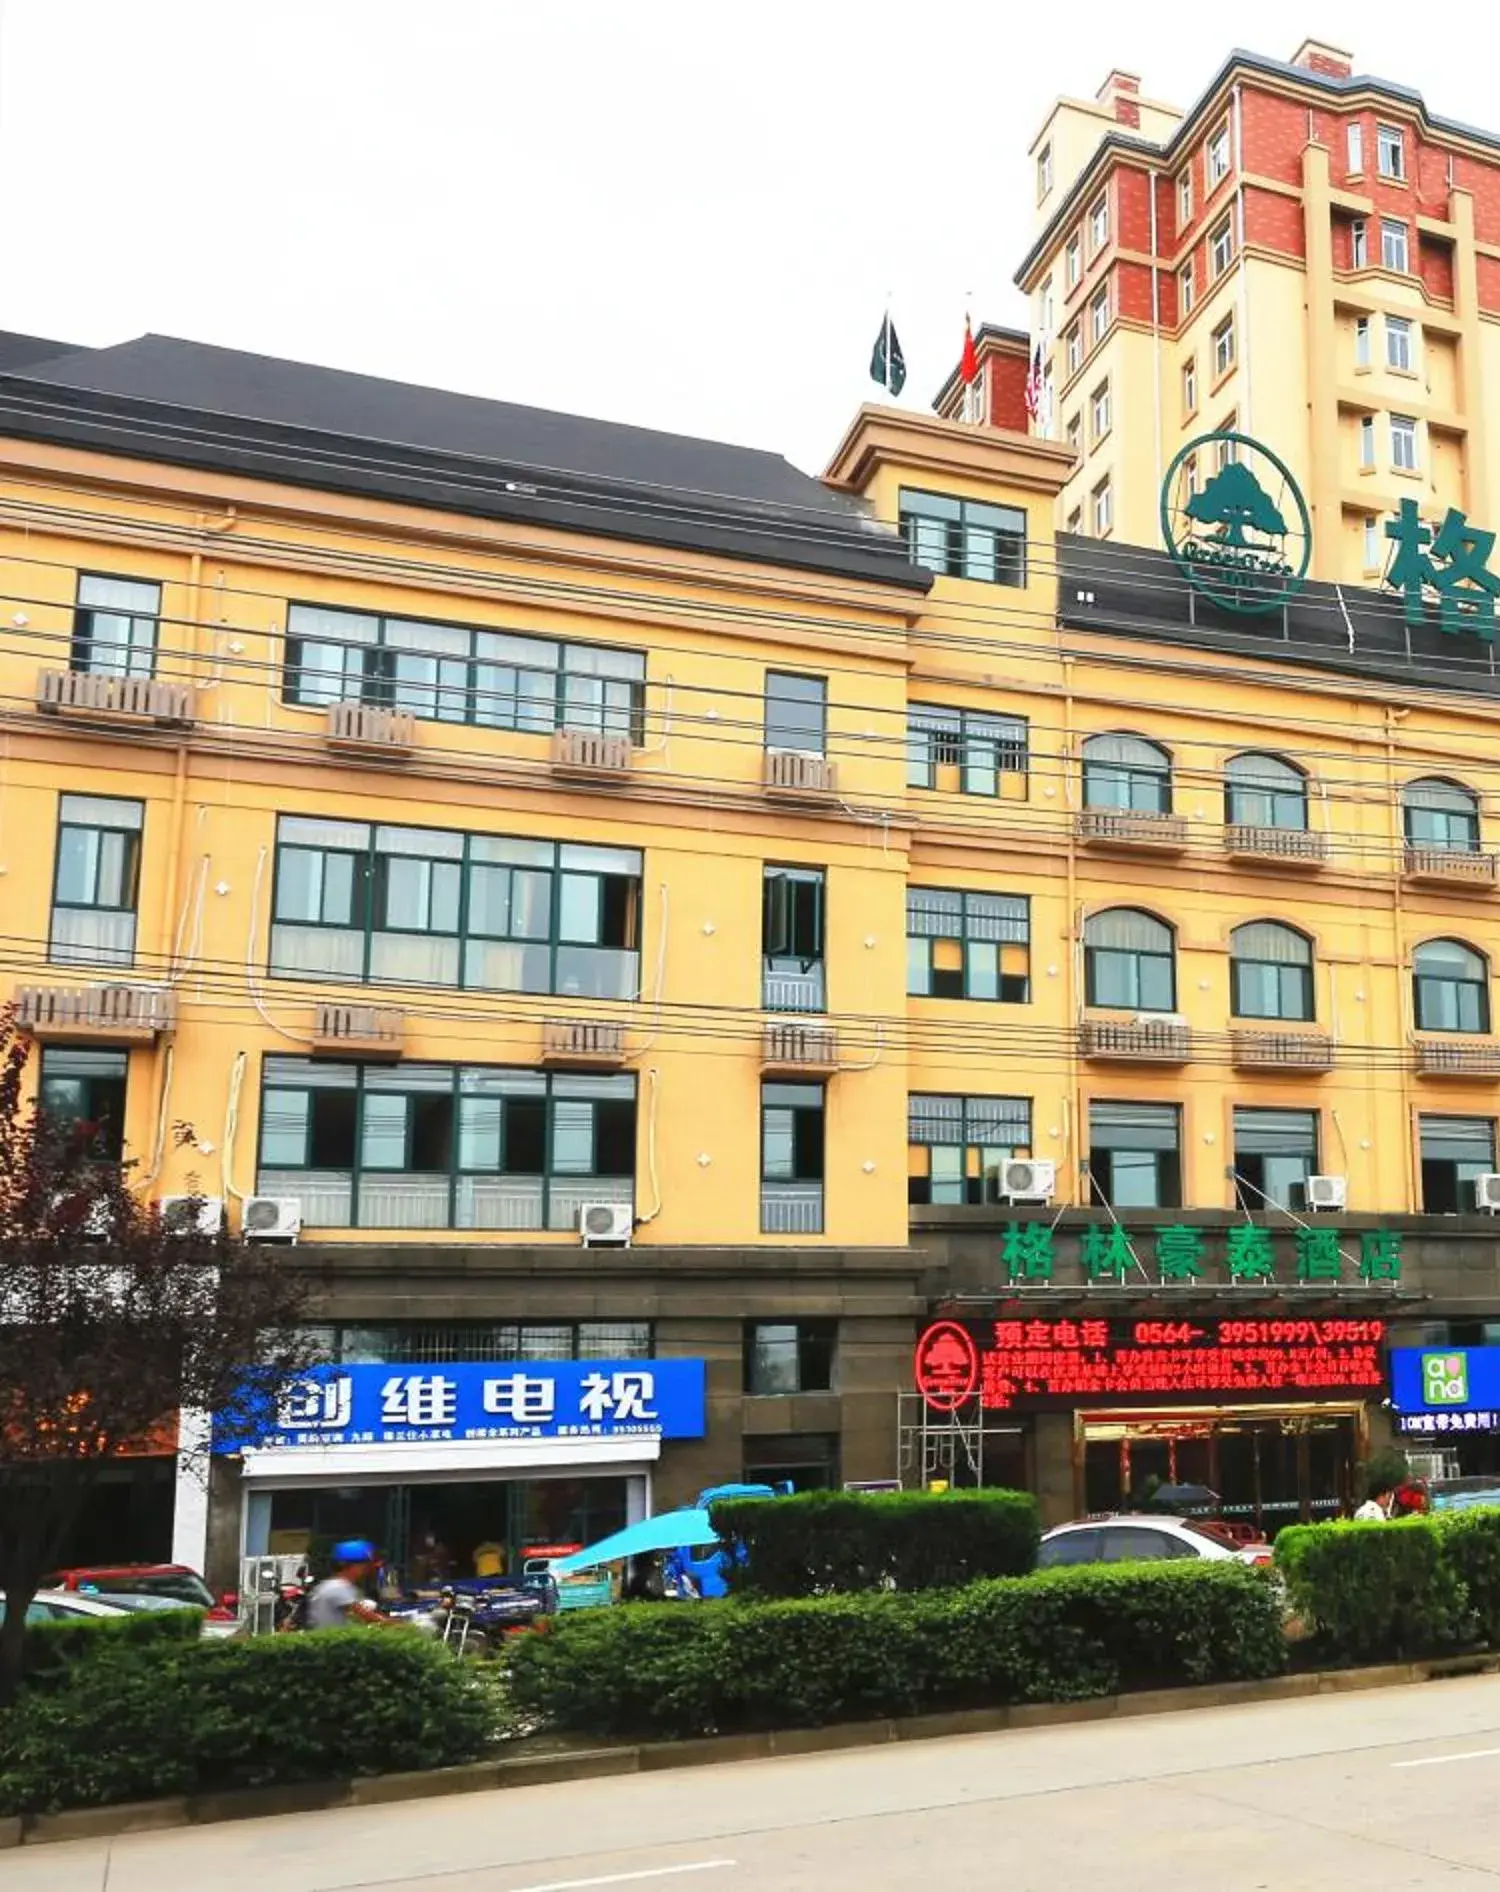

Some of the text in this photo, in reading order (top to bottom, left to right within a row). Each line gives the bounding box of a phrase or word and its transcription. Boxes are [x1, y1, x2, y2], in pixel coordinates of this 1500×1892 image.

[1001, 1221, 1402, 1281] 格林豪泰酒店
[1134, 1321, 1205, 1344] 0564-
[277, 1371, 659, 1428] 创维电视
